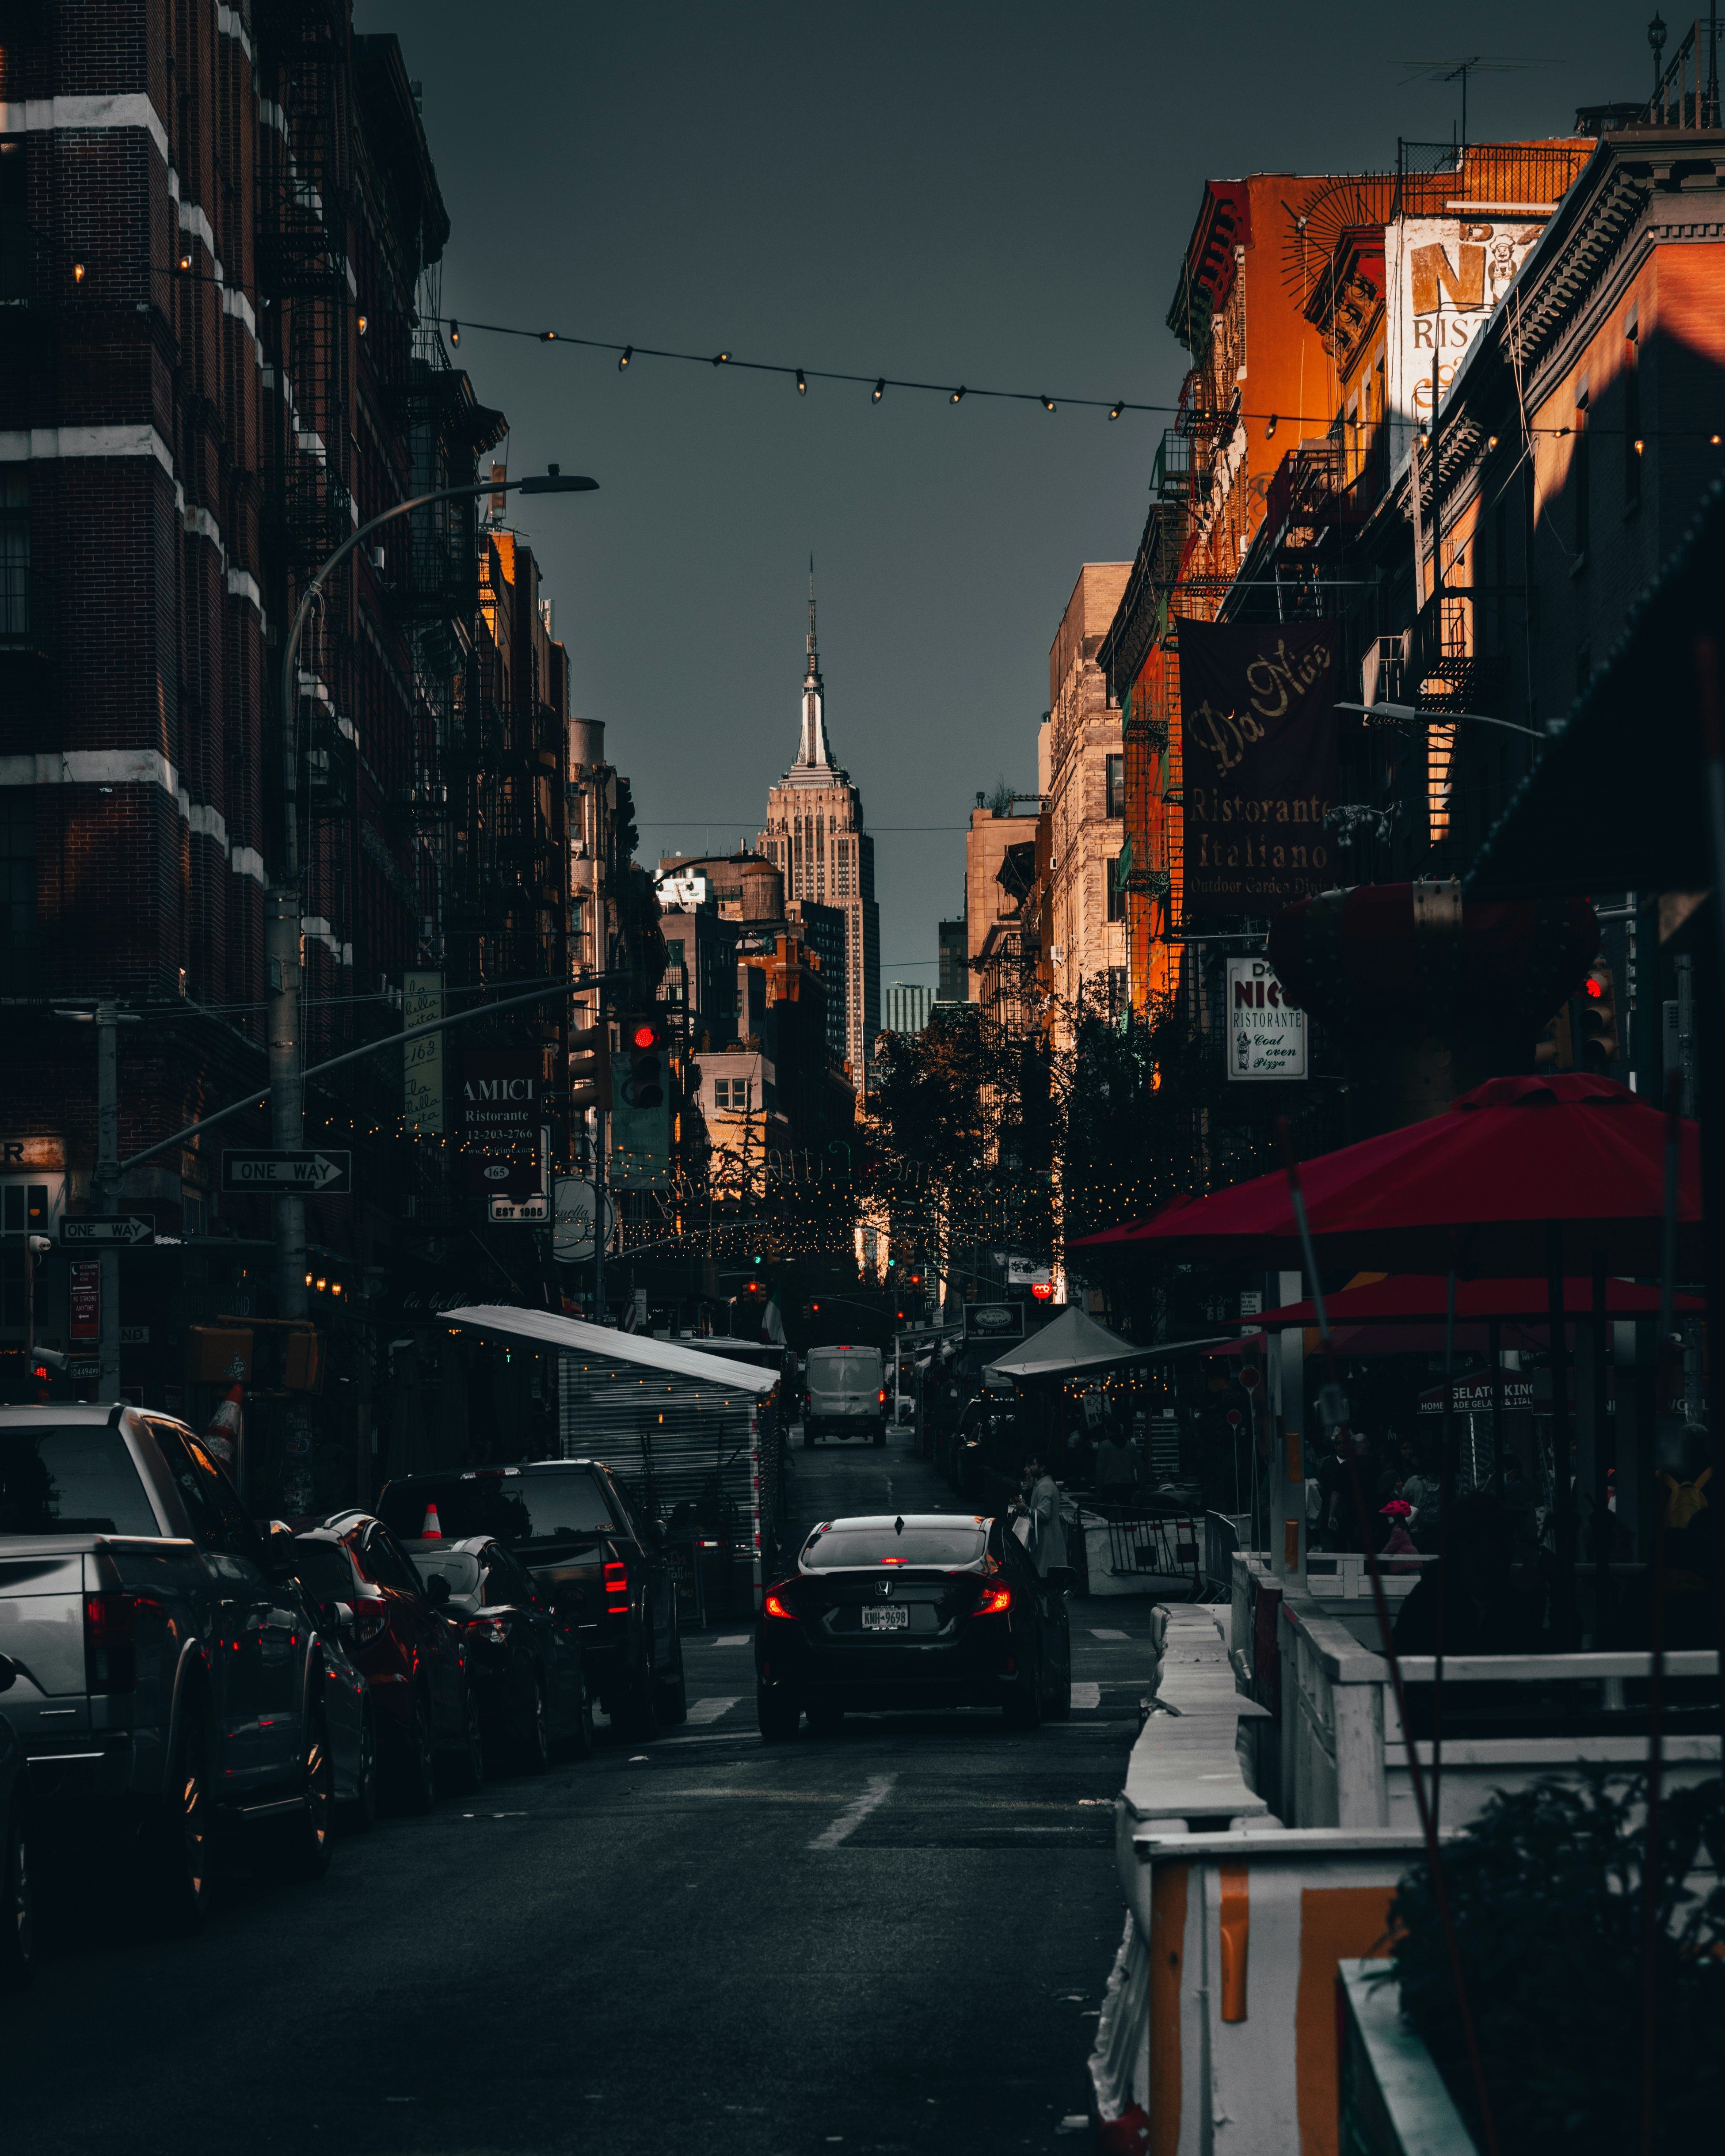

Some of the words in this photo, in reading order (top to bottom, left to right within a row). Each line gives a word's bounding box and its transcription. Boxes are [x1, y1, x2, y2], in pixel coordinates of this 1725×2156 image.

[1188, 700, 1264, 778] Da
[1247, 639, 1330, 717] Nico
[1199, 832, 1327, 868] Italiano
[1191, 876, 1241, 893] Outdoor
[1246, 877, 1287, 893] Garden
[406, 995, 439, 1015] bella
[408, 1013, 438, 1028] vita
[1234, 1013, 1301, 1027] RISTORANTE
[1254, 1034, 1284, 1046] Coal
[1266, 1048, 1297, 1057] oven
[1253, 1058, 1286, 1070] Pizza
[408, 1079, 430, 1096] la
[464, 1079, 534, 1101] AMICI
[407, 1094, 440, 1114] bella
[409, 1112, 440, 1127] vita
[465, 1110, 529, 1122] Ristorante
[465, 1129, 533, 1140] 12-203-2766
[241, 1163, 277, 1179] ONE
[293, 1164, 331, 1180] WAY
[488, 1167, 505, 1177] 165
[495, 1208, 515, 1217] EST
[520, 1207, 543, 1217] 1985
[68, 1224, 95, 1236] ONE
[111, 1224, 141, 1236] WAY
[213, 1295, 250, 1316] GRAND
[404, 1291, 423, 1308] la
[429, 1292, 472, 1308] bella
[1452, 1386, 1493, 1399] GELAT
